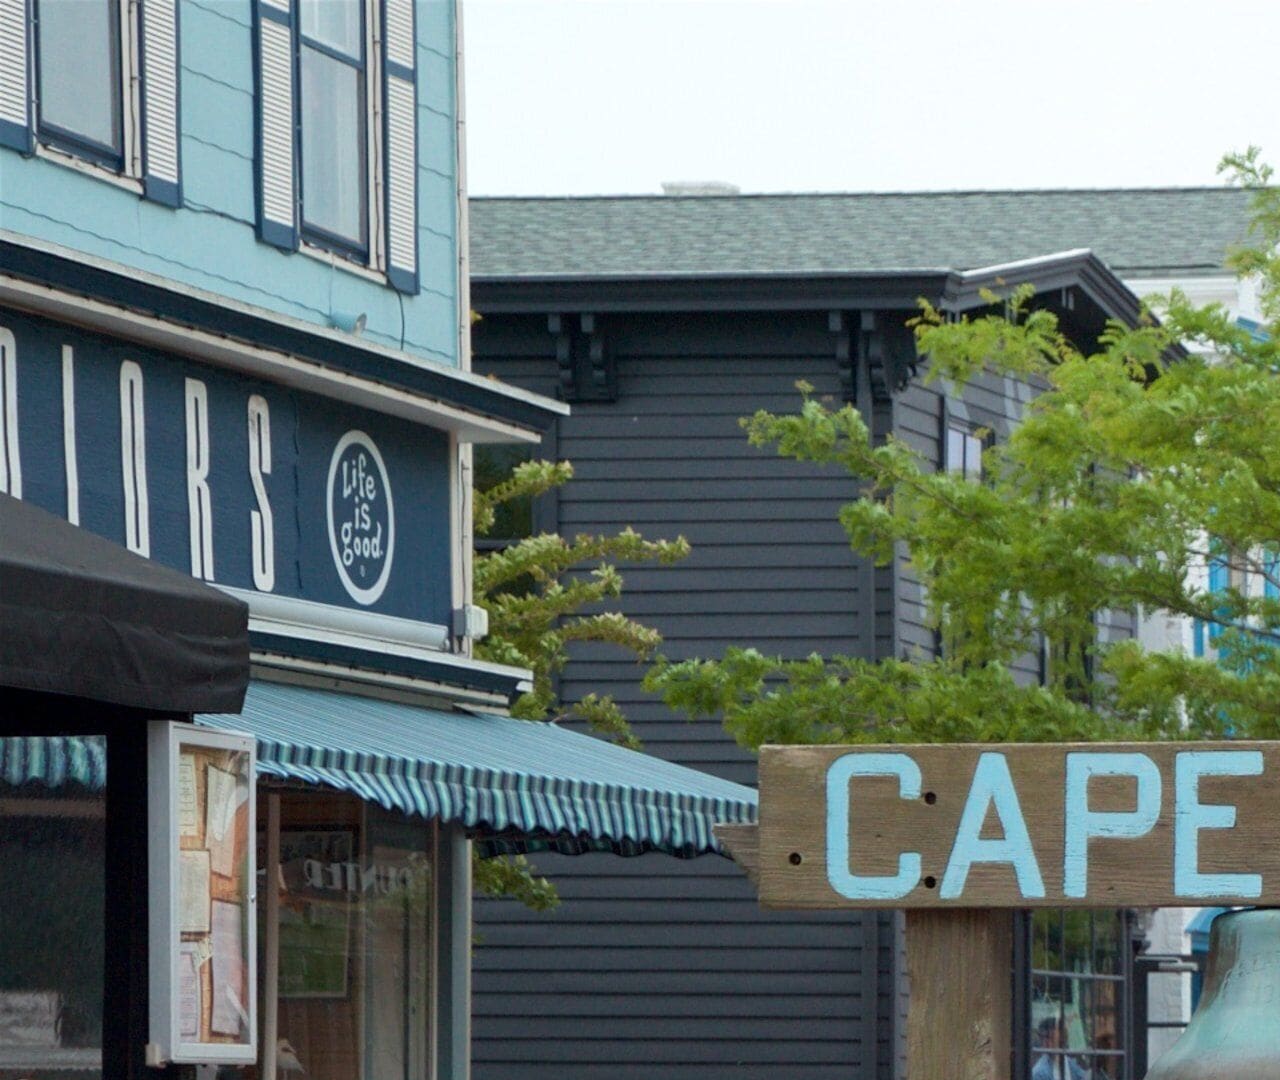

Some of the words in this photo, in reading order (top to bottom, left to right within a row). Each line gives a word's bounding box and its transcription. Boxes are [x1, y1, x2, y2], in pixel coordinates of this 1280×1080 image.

[342, 453, 376, 500] Life
[354, 495, 371, 530] is
[826, 750, 1264, 899] CAPE
